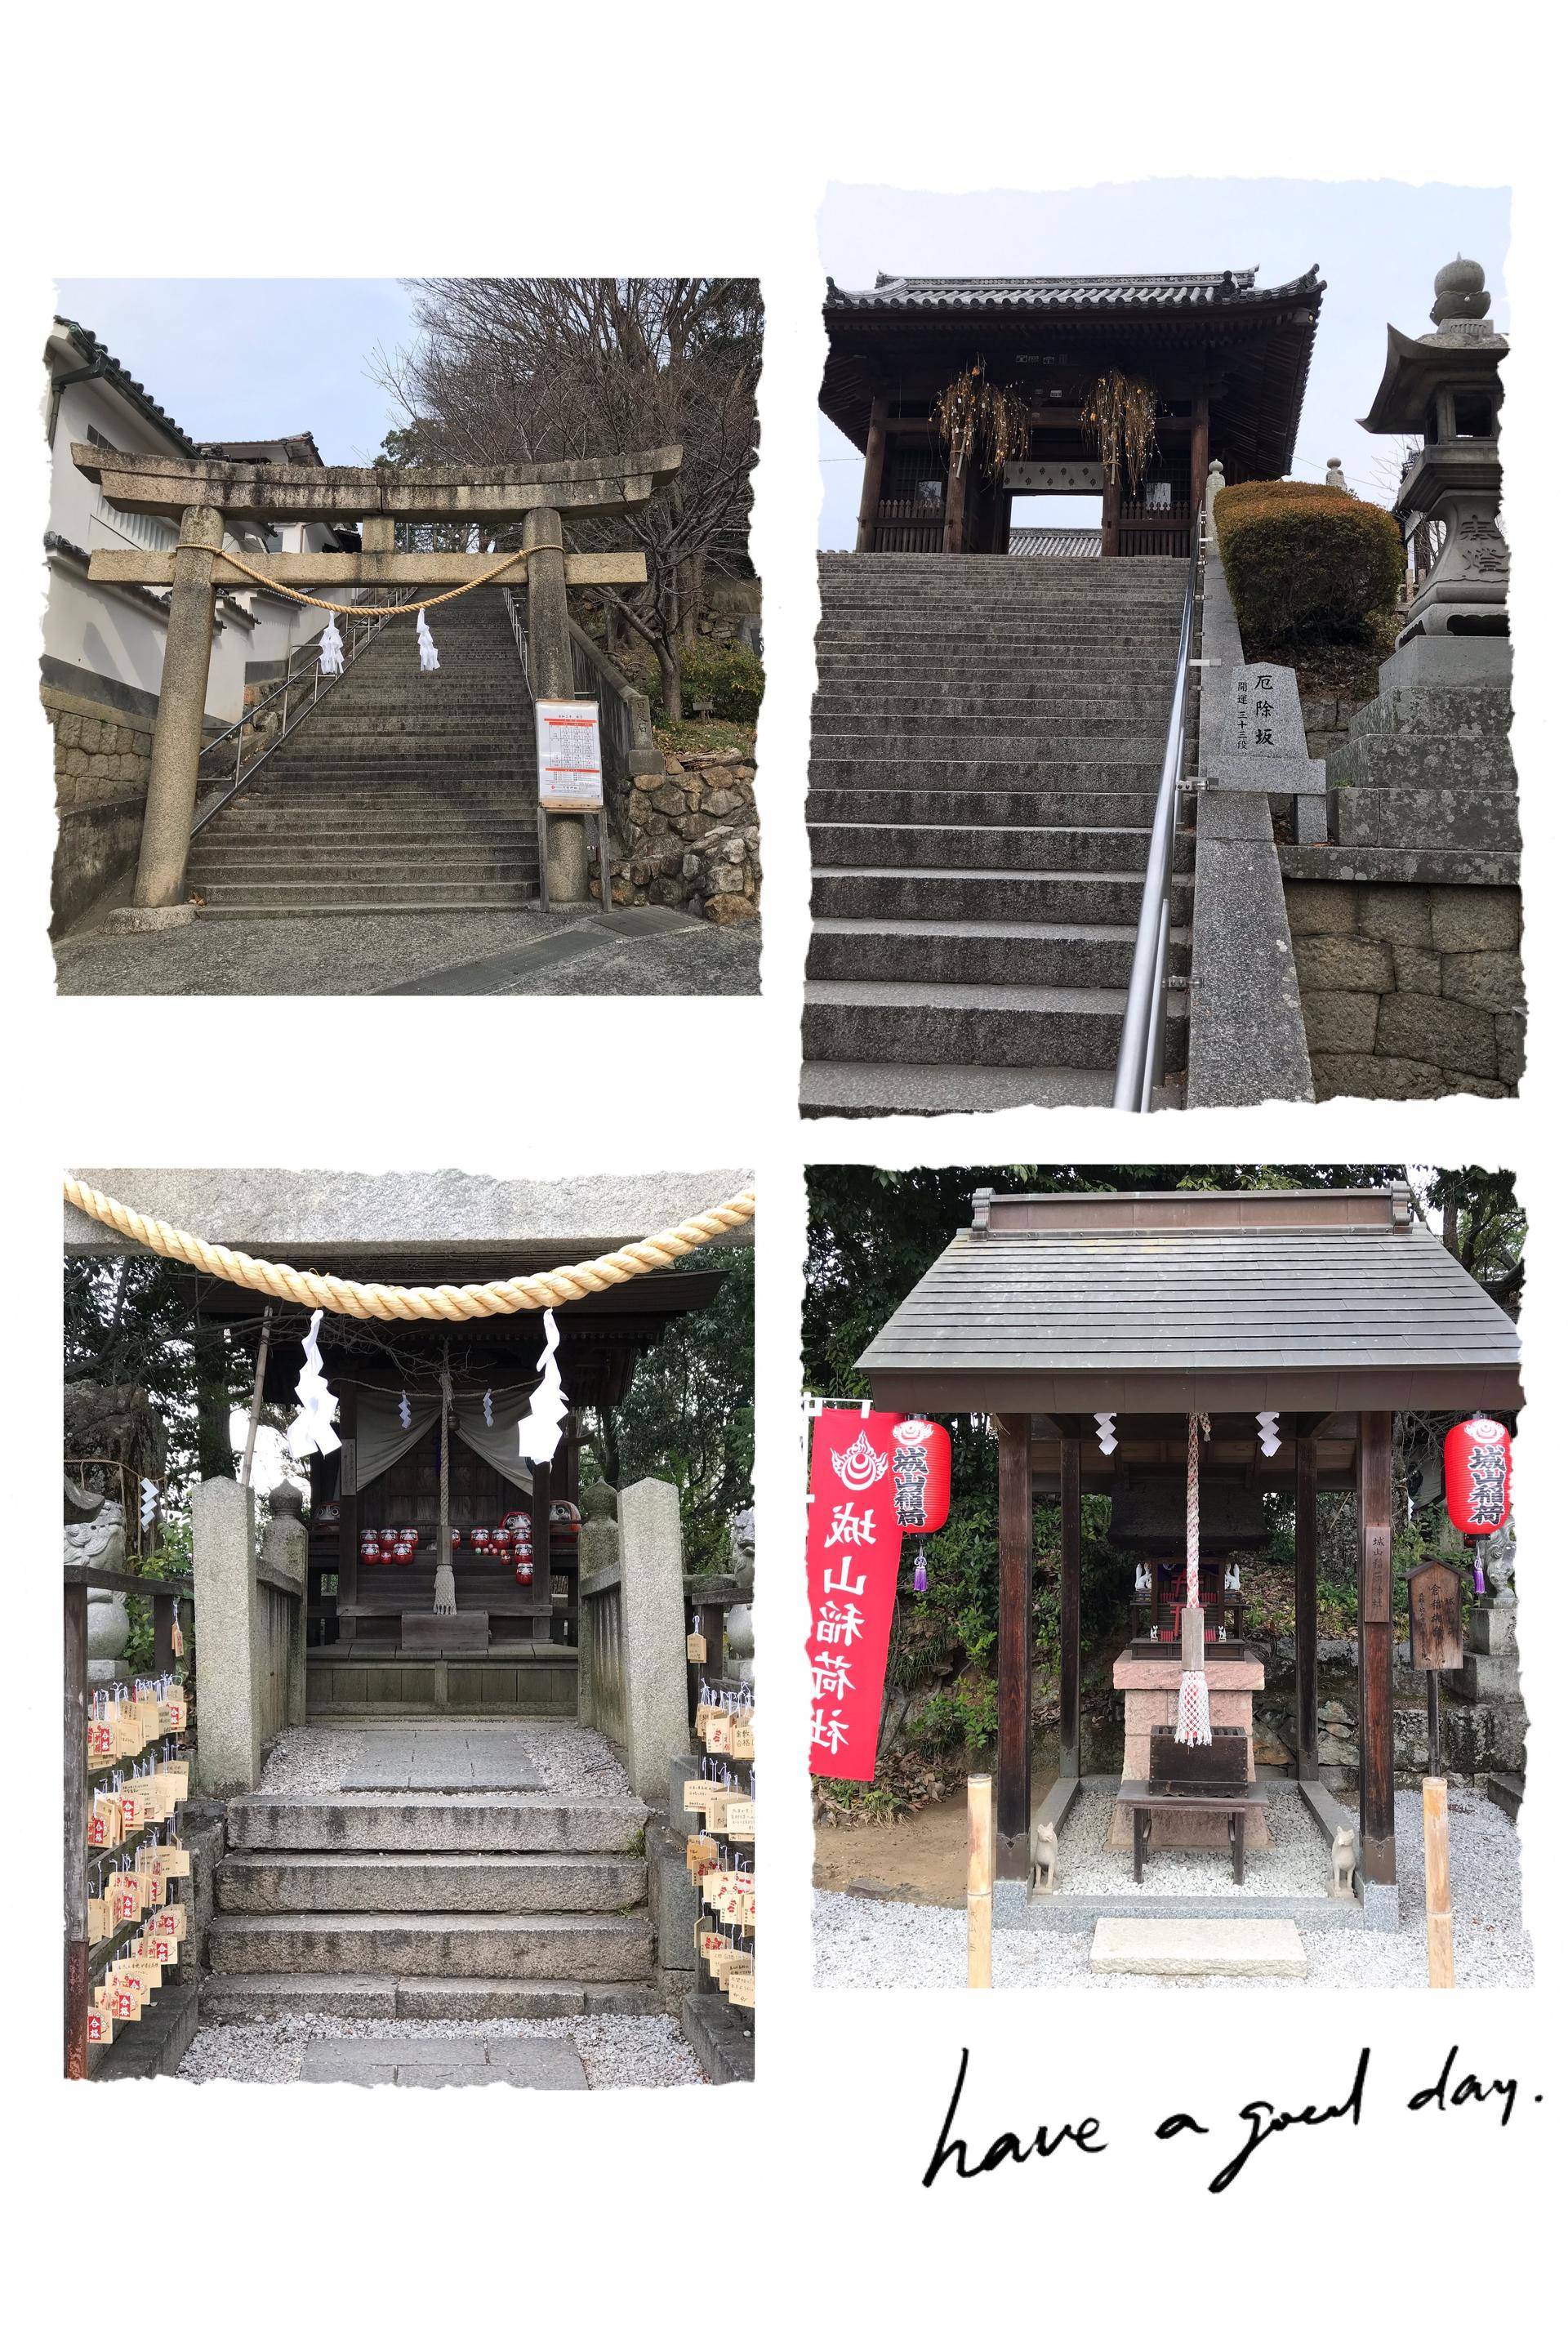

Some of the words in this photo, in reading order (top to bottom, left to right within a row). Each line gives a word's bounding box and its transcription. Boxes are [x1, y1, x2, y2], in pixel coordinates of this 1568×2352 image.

[1237, 682, 1248, 705] 開運
[1254, 675, 1274, 746] 厄除坂
[1237, 711, 1248, 751] 三十三段
[893, 1446, 929, 1527] 城山稲荷
[1468, 1446, 1507, 1526] 城山稲荷
[119, 1996, 130, 2016] 合格
[89, 2017, 100, 2038] 合格
